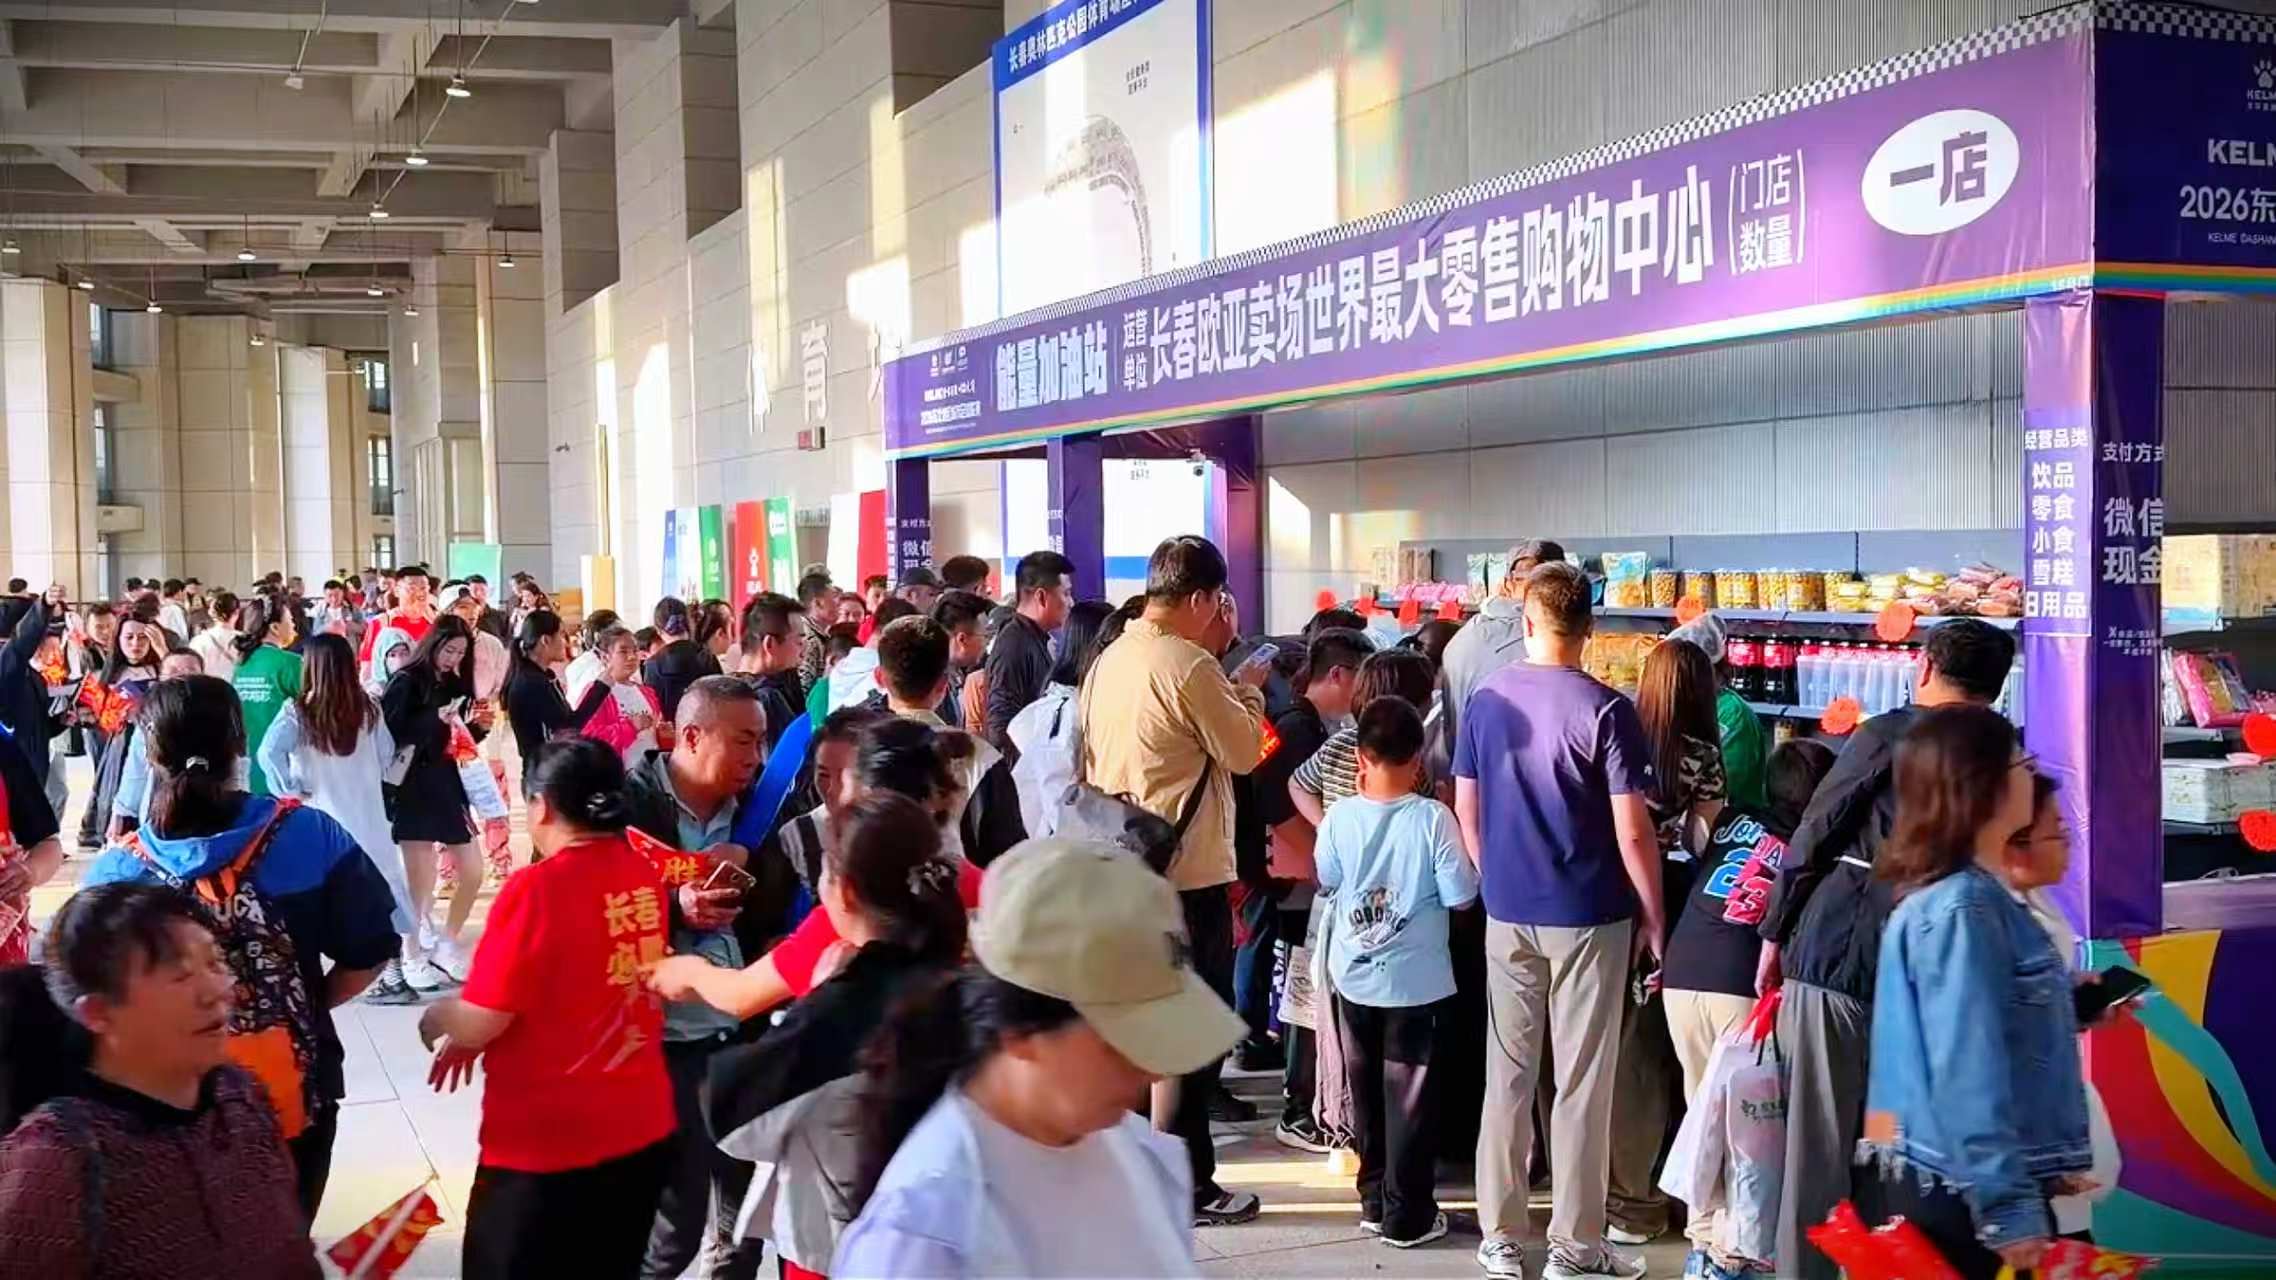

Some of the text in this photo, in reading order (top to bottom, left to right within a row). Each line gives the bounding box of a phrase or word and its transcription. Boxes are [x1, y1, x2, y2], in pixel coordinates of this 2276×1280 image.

[1890, 130, 1987, 206] 一店
[1149, 164, 1714, 386] 长春欧亚卖场世界最大零售购物中心
[1123, 309, 1148, 349] 运营
[996, 321, 1108, 412] 能量加油站
[1122, 352, 1148, 392] 单位
[2024, 427, 2089, 450] 经营品类
[2032, 461, 2075, 490] 饮品
[2032, 493, 2076, 522] 零食
[2104, 497, 2164, 538] 微信
[2032, 526, 2076, 555] 小食
[2032, 558, 2075, 587] 雪糕
[2103, 545, 2162, 585] 现金
[2025, 590, 2088, 619] 日用品
[603, 886, 661, 937] 长春
